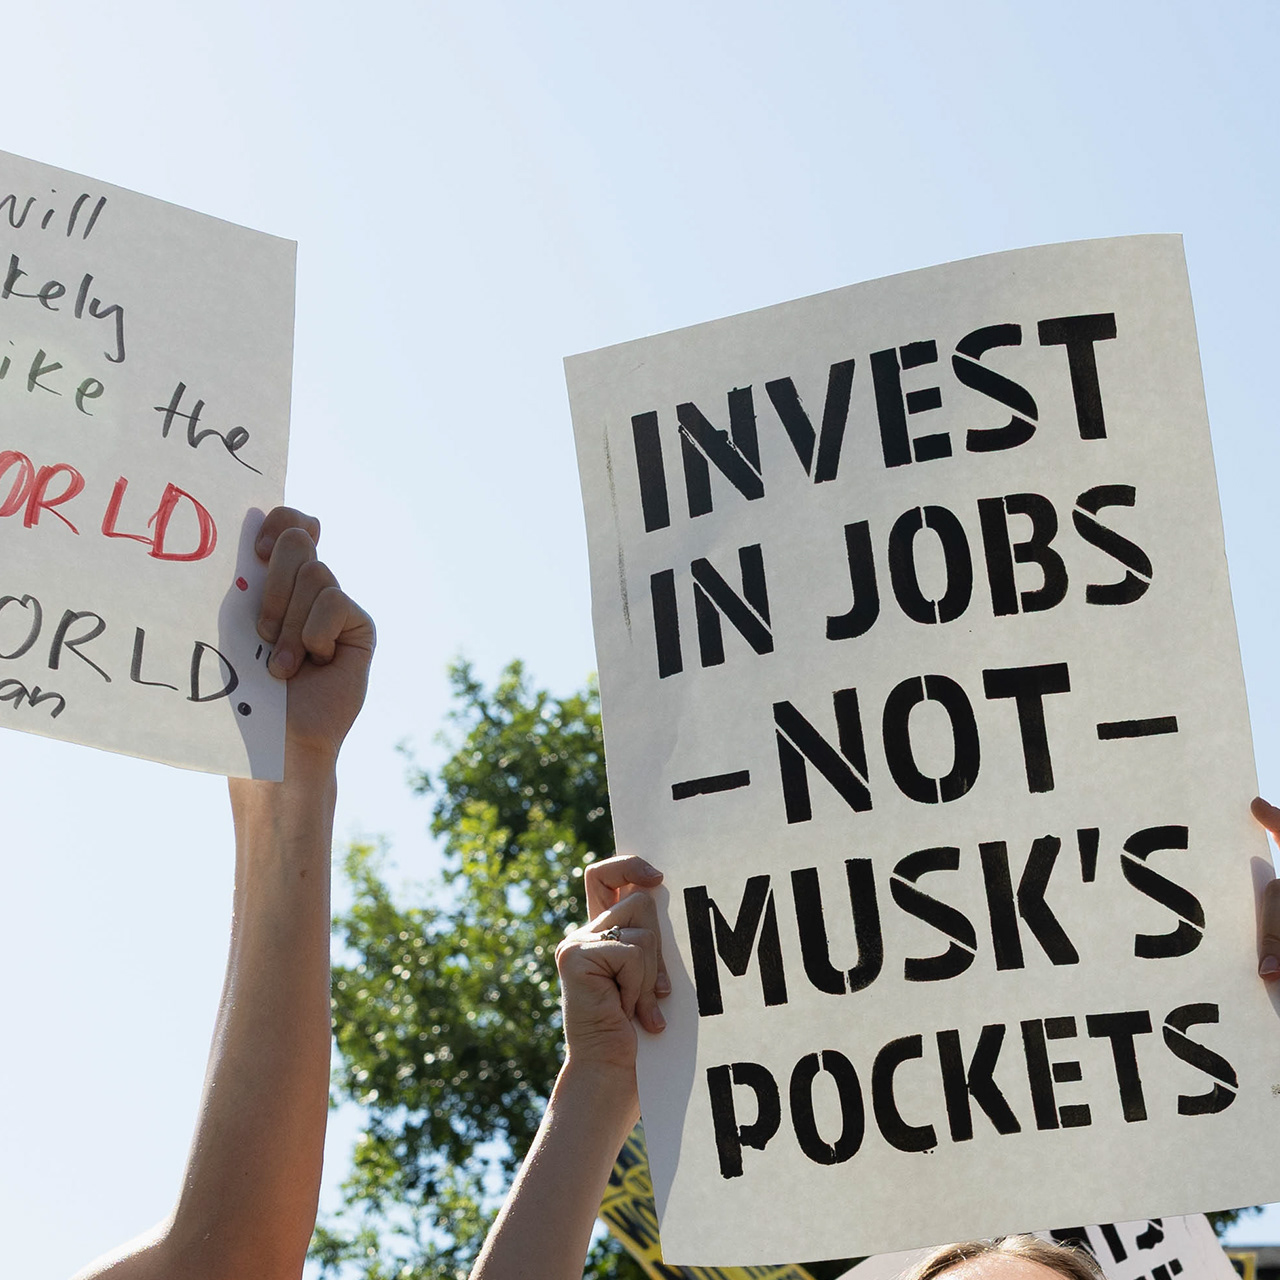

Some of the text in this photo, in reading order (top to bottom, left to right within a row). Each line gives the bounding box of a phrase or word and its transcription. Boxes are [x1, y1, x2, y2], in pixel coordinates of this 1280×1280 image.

[153, 381, 264, 476] the
[630, 311, 1119, 534] INVEST
[649, 484, 1154, 681] IN JOBS
[682, 825, 1206, 1019] MUSK'S
[705, 1002, 1239, 1181] POCKETS
